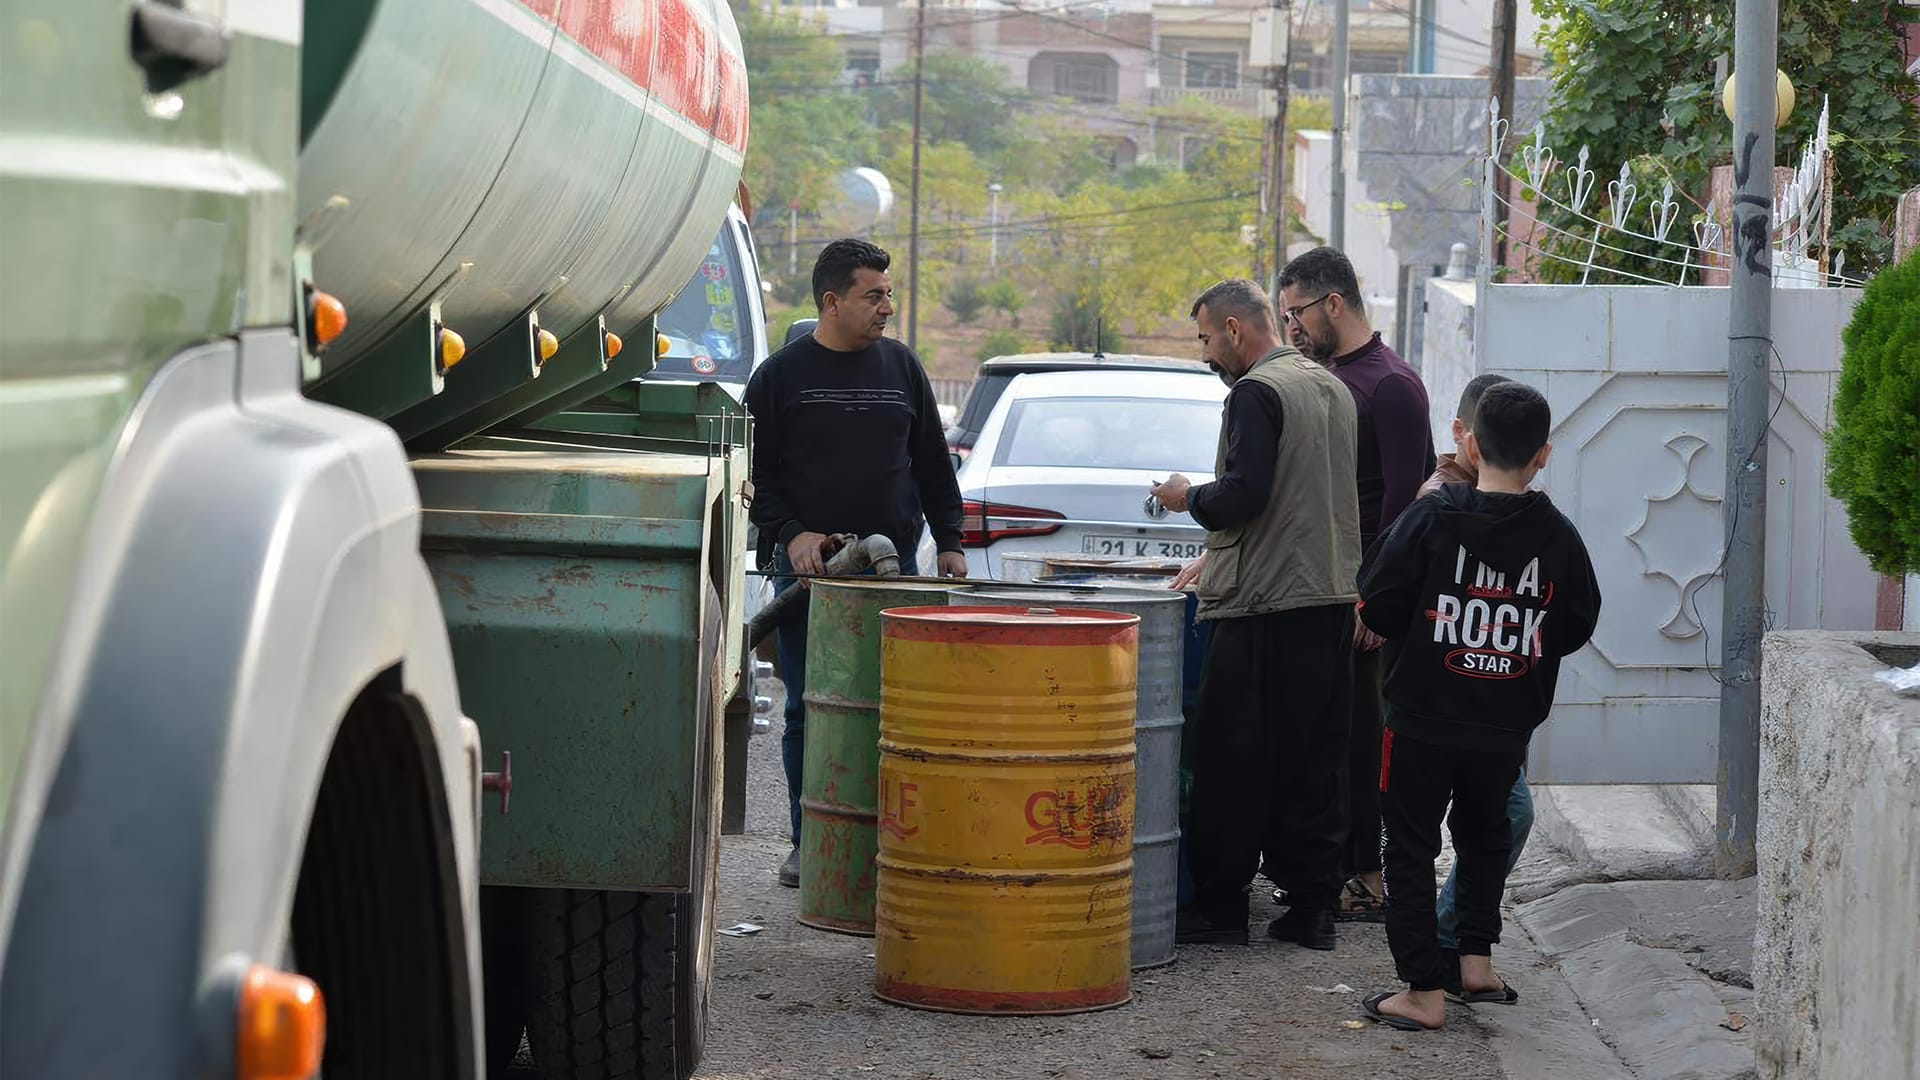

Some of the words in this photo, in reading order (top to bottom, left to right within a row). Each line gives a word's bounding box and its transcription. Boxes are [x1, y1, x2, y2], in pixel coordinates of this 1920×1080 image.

[1101, 541, 1124, 555] 21
[1136, 541, 1148, 556] K
[1516, 556, 1539, 597] A
[1433, 594, 1547, 657] ROCK
[1463, 653, 1512, 674] STAR
[882, 779, 919, 824] LF
